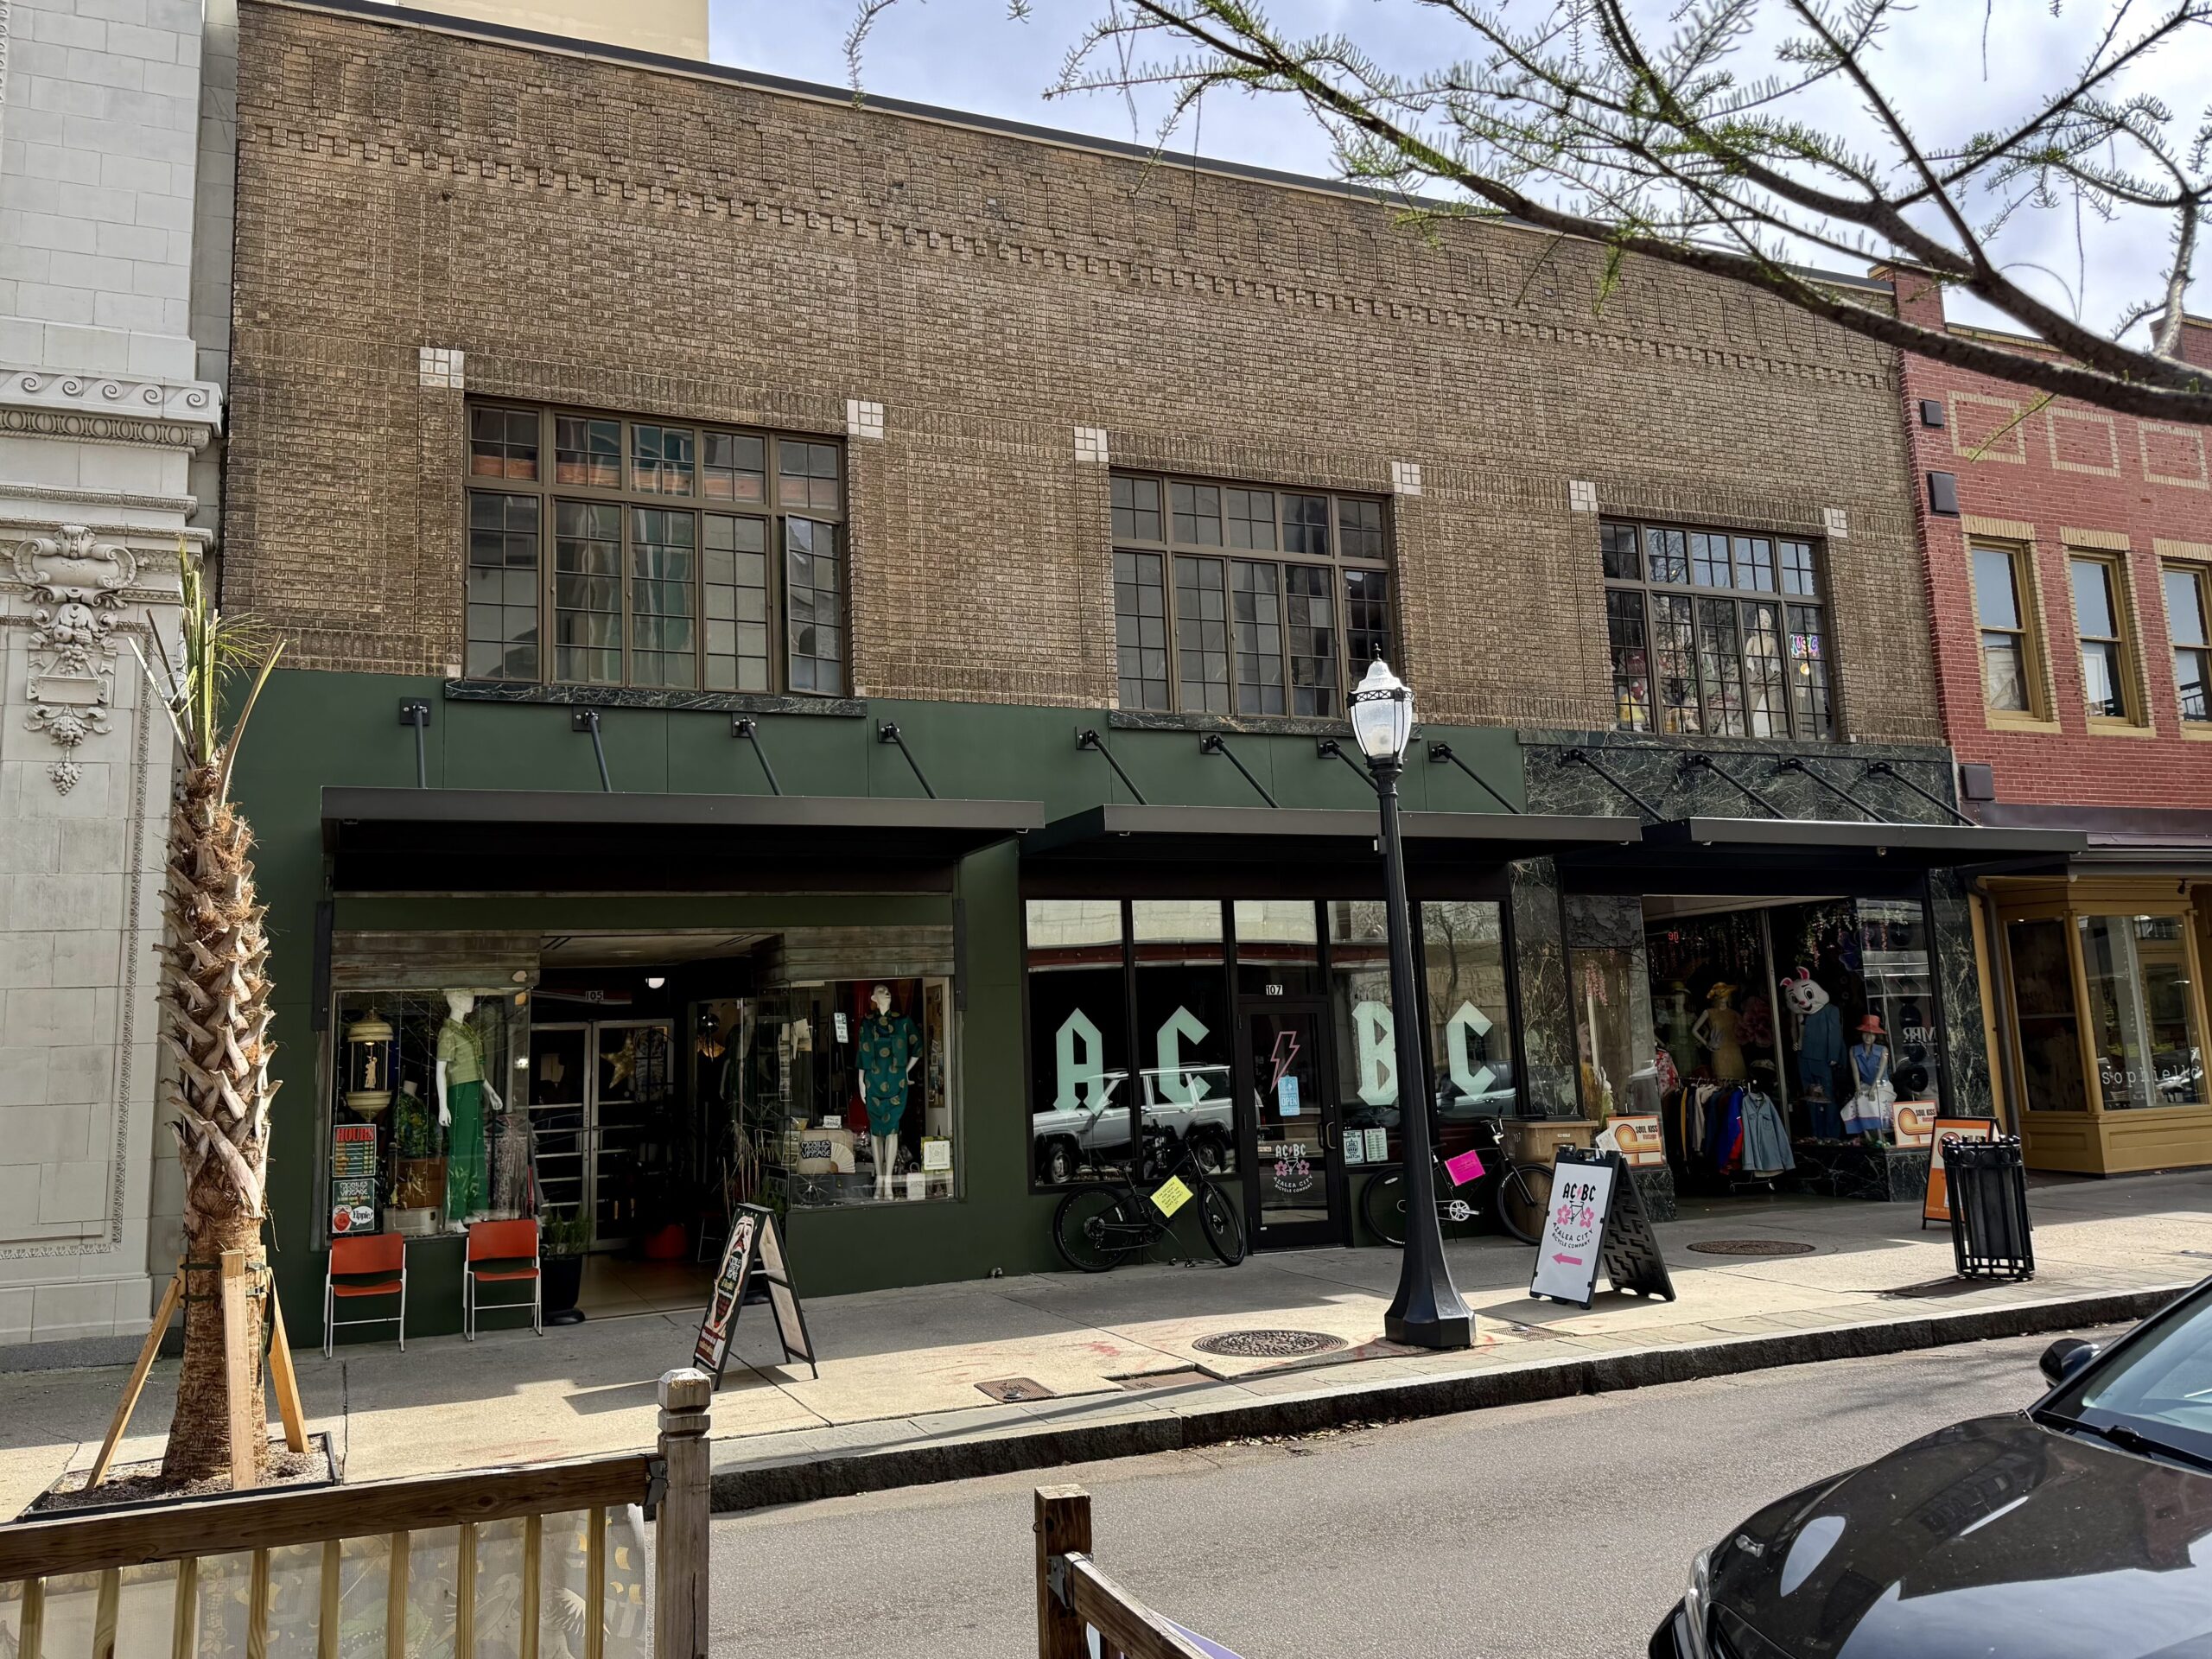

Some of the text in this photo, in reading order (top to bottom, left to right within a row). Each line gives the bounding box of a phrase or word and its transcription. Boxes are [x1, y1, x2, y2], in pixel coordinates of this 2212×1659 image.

[587, 991, 603, 1001] 105
[1266, 985, 1282, 995] 107
[1281, 1097, 1298, 1106] OPEN
[336, 1127, 374, 1141] HOURS
[1274, 1174, 1313, 1188] AZALEA CITY
[1274, 1182, 1313, 1192] BICYCLE COMPANY
[1553, 1222, 1593, 1242] AZALEA CITY
[1552, 1232, 1591, 1249] BICYCLE COMPANY
